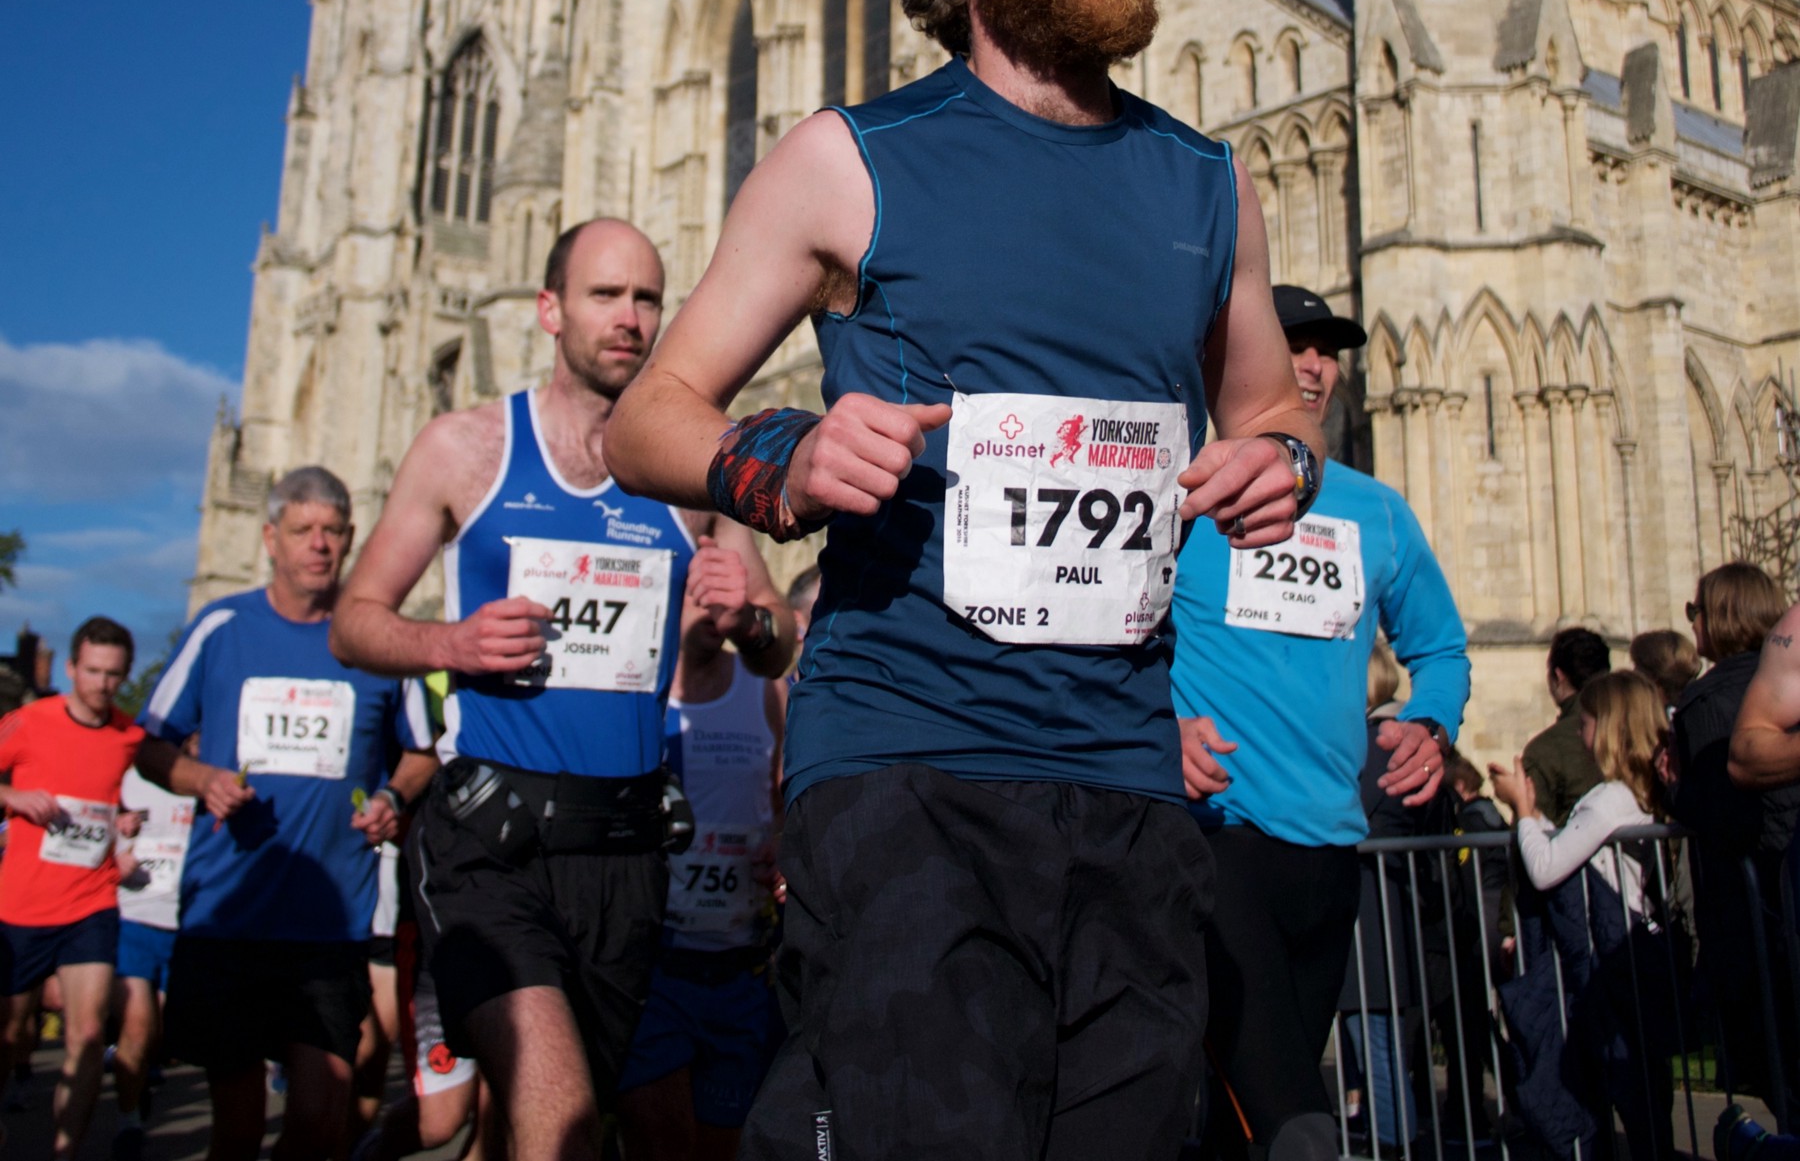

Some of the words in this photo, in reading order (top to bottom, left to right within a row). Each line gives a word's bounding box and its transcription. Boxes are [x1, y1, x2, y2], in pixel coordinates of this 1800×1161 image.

[1091, 418, 1159, 445] YORKSHIRE
[973, 440, 1045, 459] plusnet
[1088, 444, 1156, 470] MARATHON
[608, 518, 662, 539] Roundhay
[1004, 487, 1154, 551] 1792
[607, 527, 653, 545] Runners
[1300, 522, 1336, 538] YORKSHIRE
[523, 567, 567, 579] plusnet
[594, 556, 641, 573] YORKSHIRE
[1254, 549, 1342, 590] 2298
[593, 573, 641, 588] MARATHON
[1055, 566, 1102, 585] PAUL
[1282, 591, 1316, 604] CRAIG
[552, 597, 628, 634] 447
[964, 606, 1026, 625] ZONE
[1037, 608, 1049, 626] 2
[1236, 608, 1269, 620] ZONE
[1275, 613, 1282, 622] 2
[564, 642, 610, 655] JOSEPH
[266, 713, 329, 739] 1152
[686, 865, 739, 893] 756
[816, 1130, 828, 1161] AKTIV
